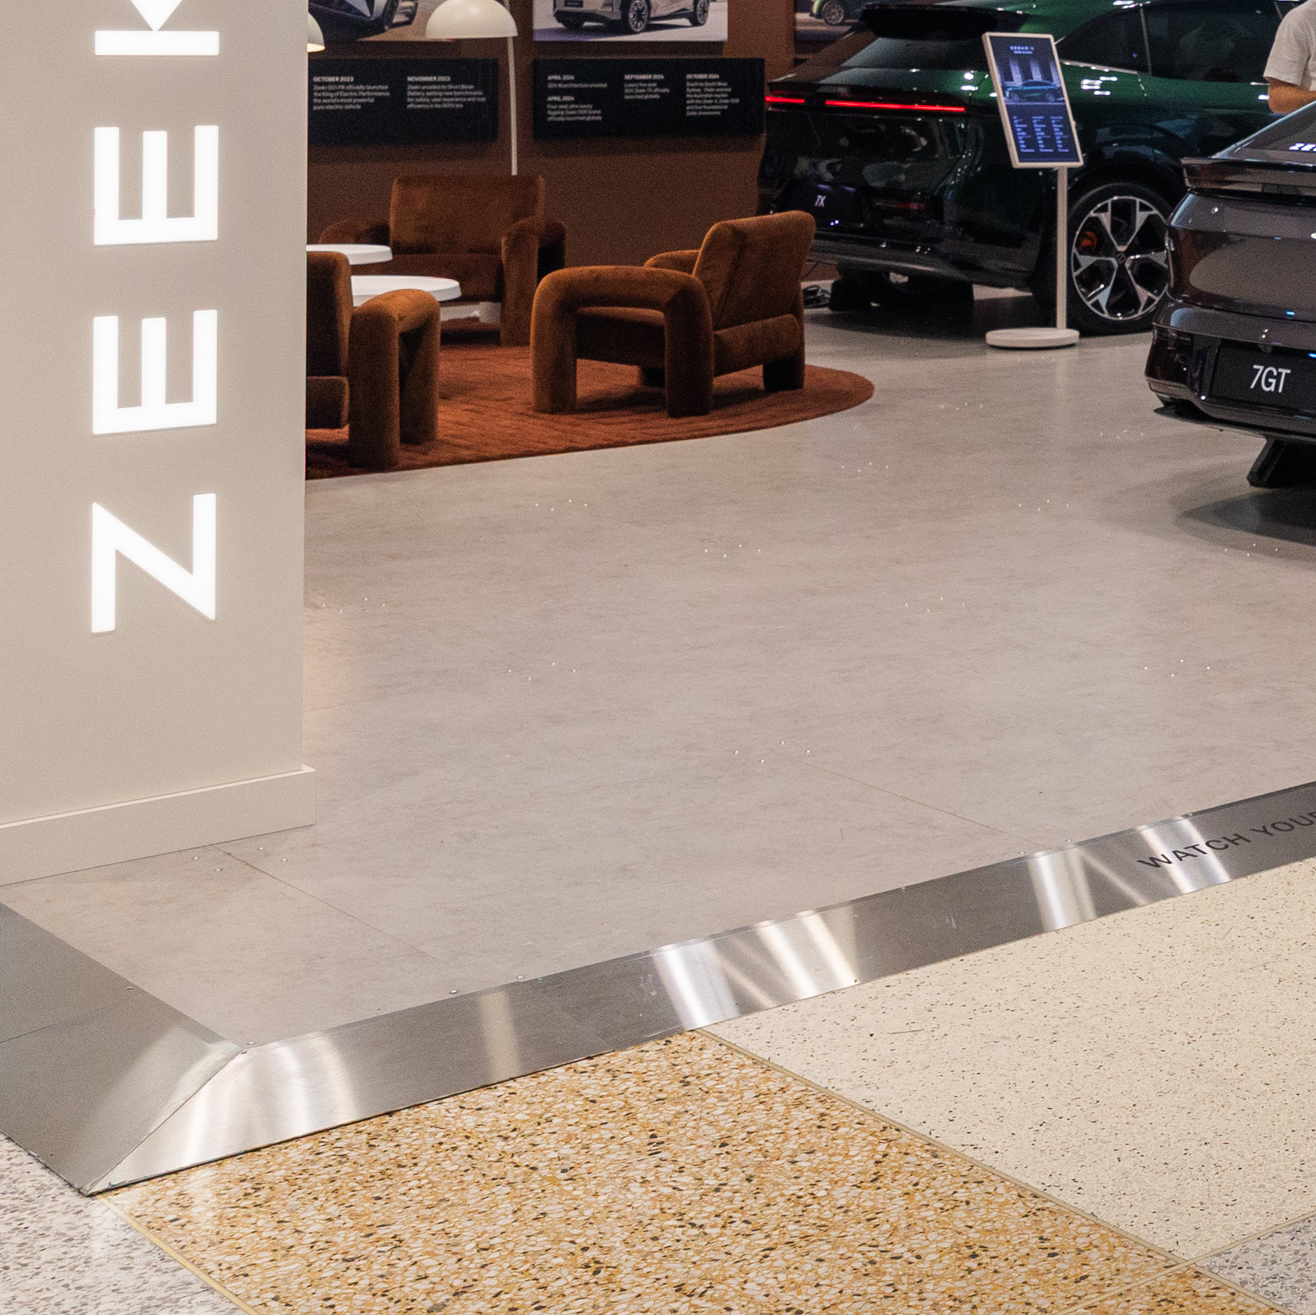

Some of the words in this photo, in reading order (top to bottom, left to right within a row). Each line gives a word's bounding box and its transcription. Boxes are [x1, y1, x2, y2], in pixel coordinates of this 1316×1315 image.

[814, 194, 827, 208] 7X
[1250, 364, 1291, 393] 7GT
[1137, 832, 1252, 870] WATCH
